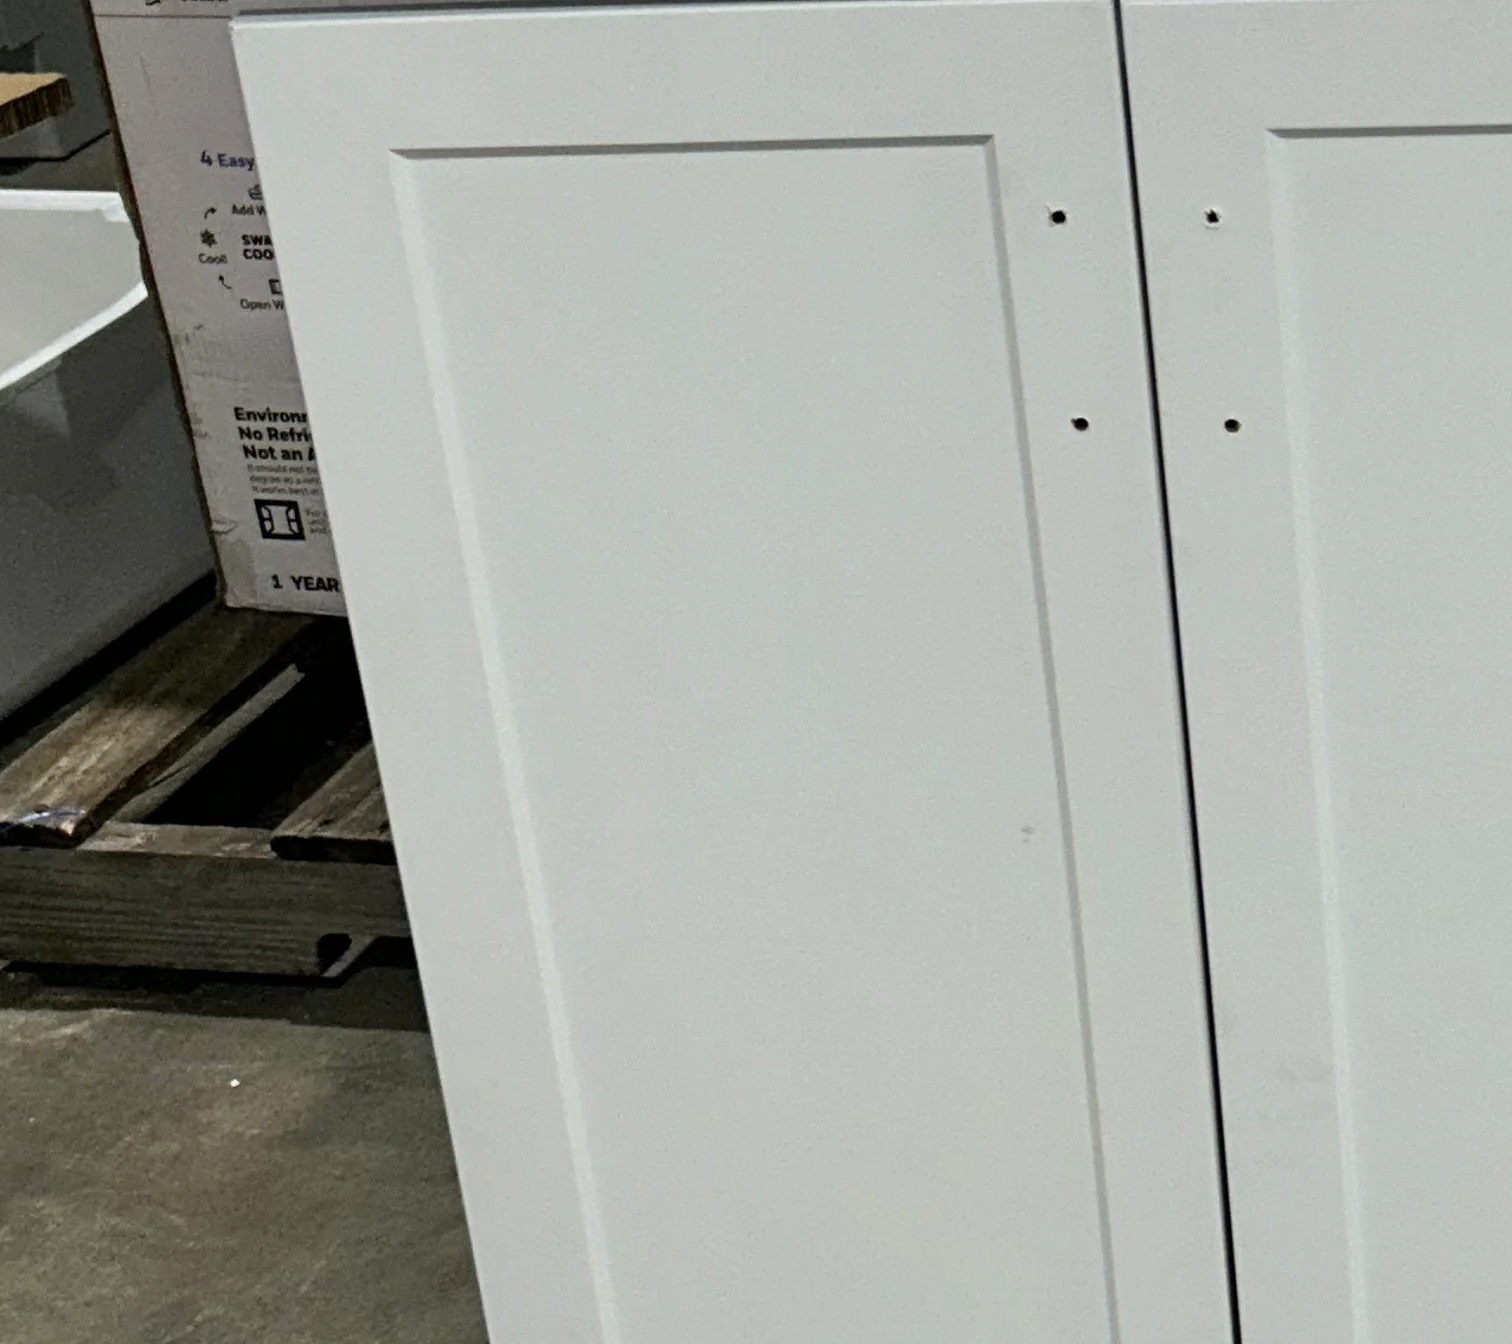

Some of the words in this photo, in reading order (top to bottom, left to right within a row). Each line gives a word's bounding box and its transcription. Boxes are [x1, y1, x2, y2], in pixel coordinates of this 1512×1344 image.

[200, 150, 213, 167] 4
[216, 152, 256, 171] Easy
[231, 203, 255, 216] Add
[243, 248, 275, 261] COO
[239, 297, 272, 311] Open
[237, 426, 263, 441] No
[242, 444, 278, 461] Not
[280, 448, 303, 462] an
[271, 573, 284, 590] 1
[290, 574, 340, 593] YEAR
